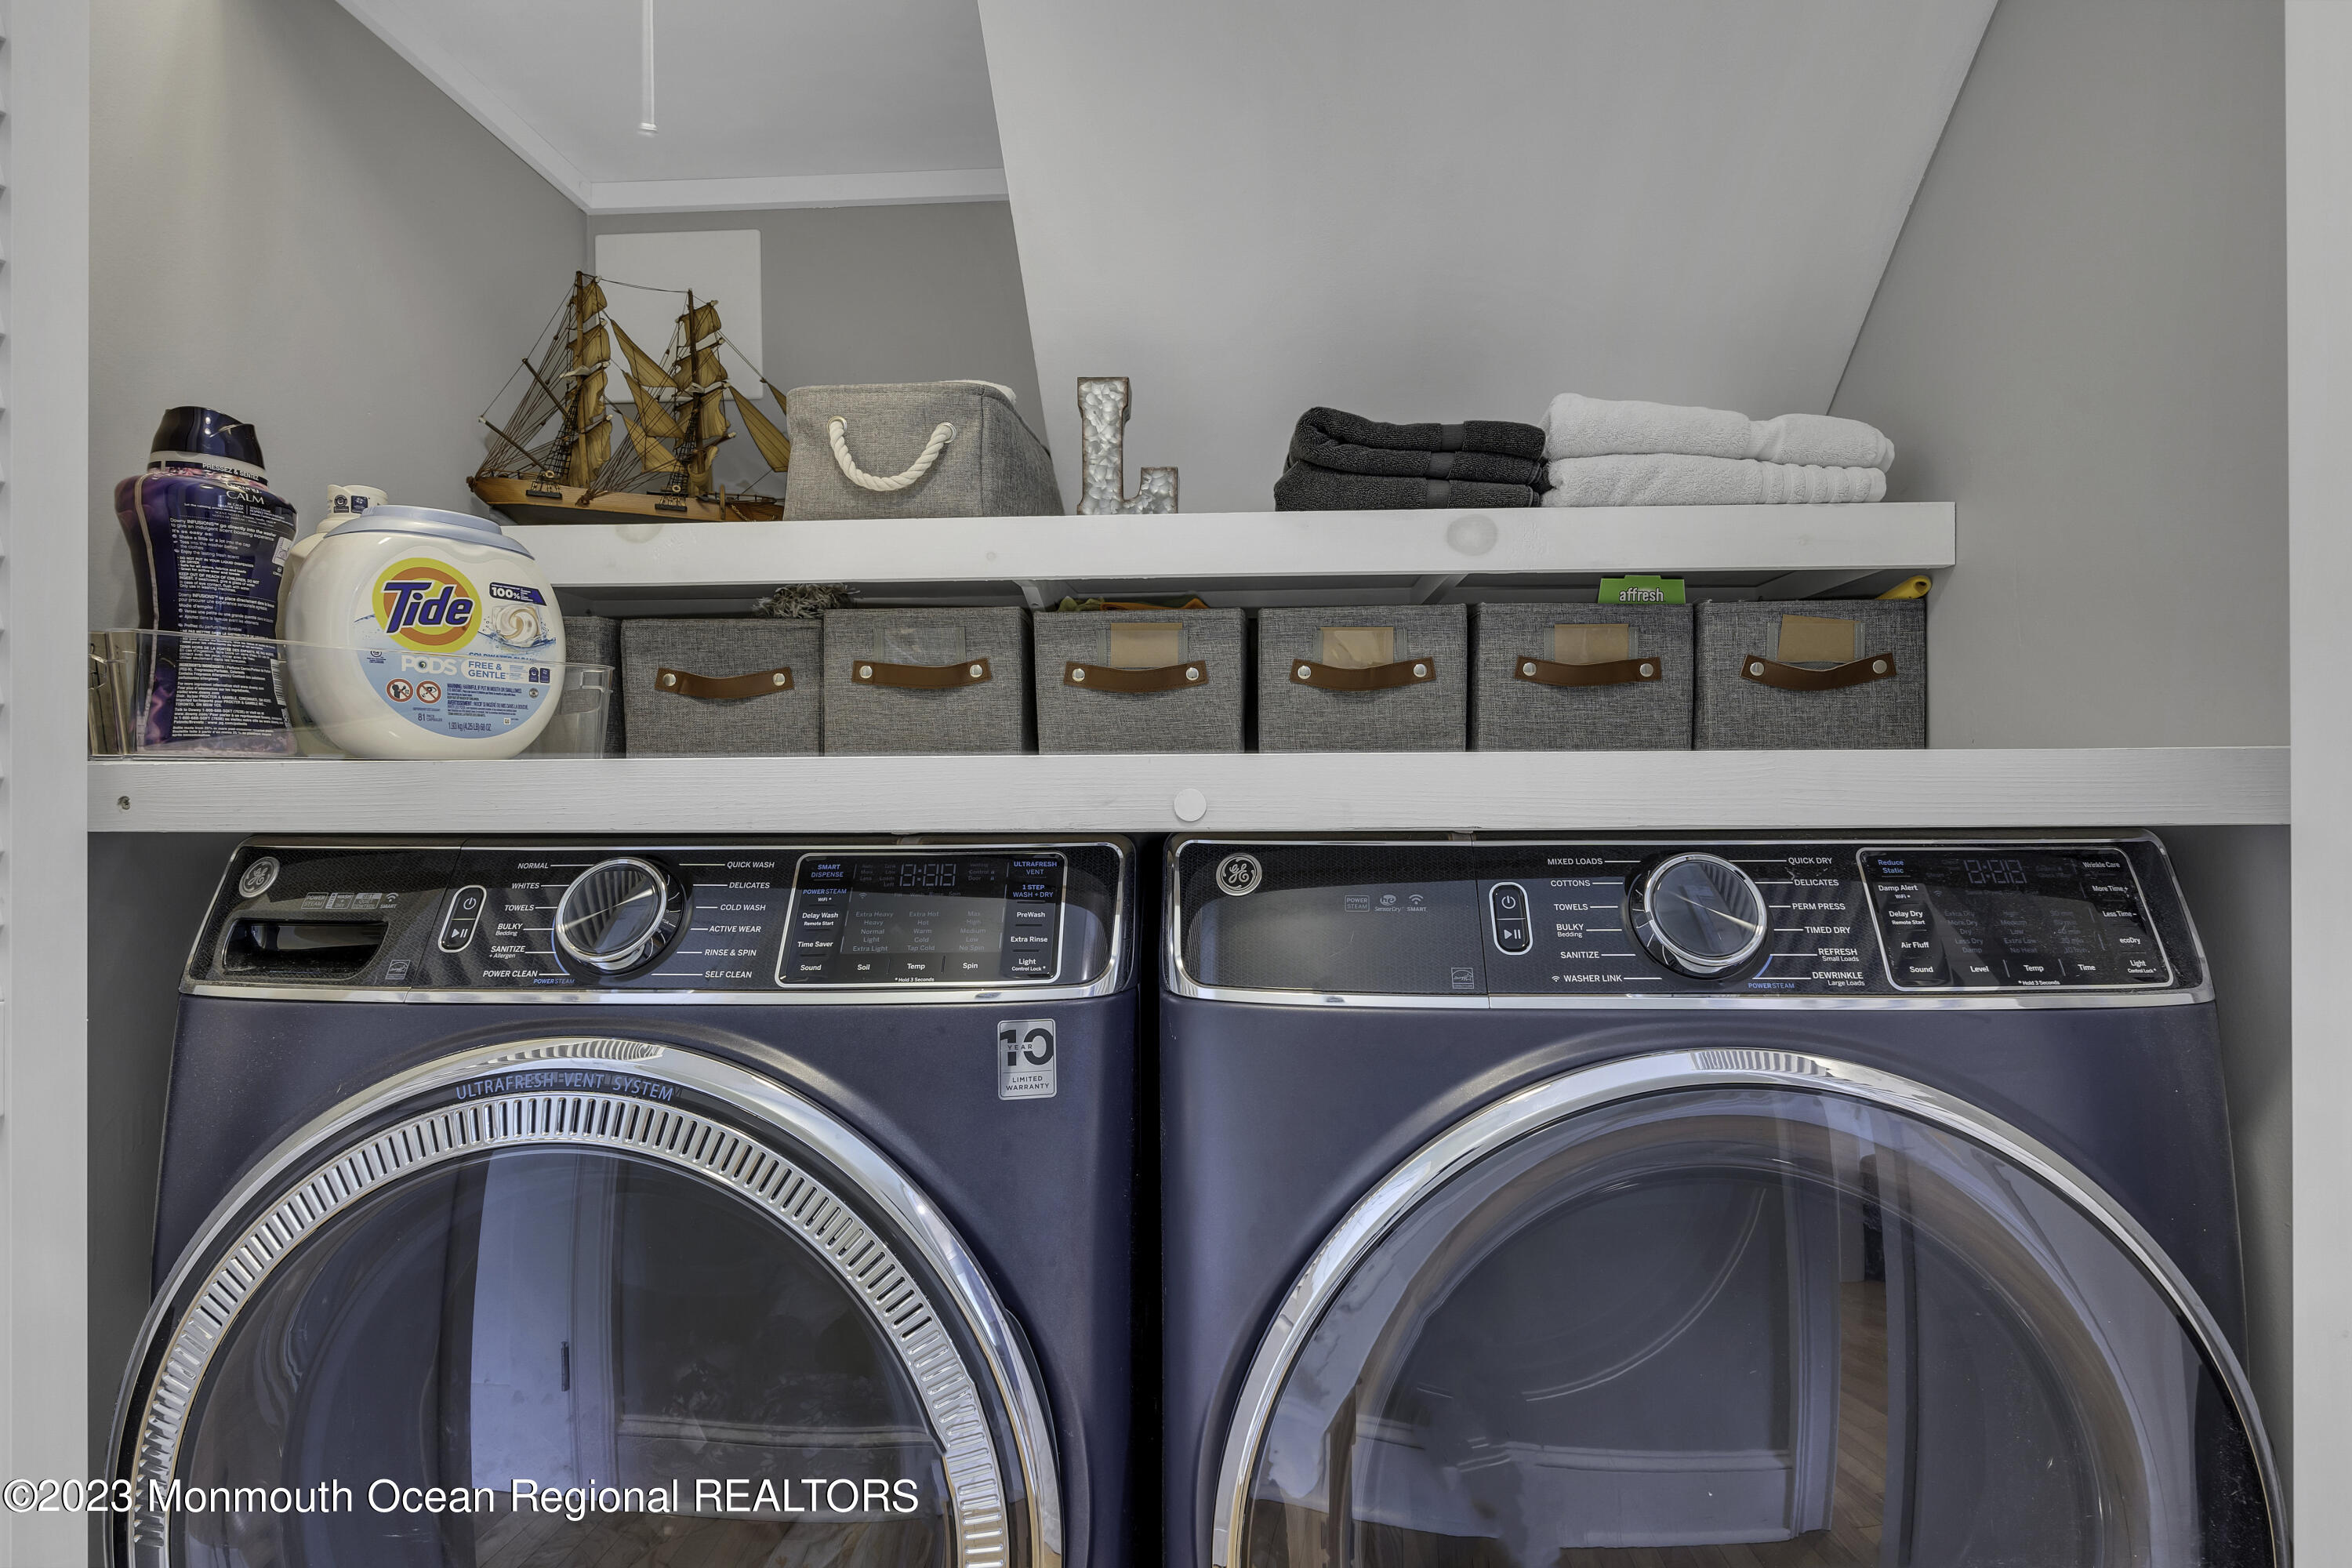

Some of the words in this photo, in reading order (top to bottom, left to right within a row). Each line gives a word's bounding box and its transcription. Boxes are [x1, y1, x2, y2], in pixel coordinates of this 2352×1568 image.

[202, 463, 232, 474] PRESSEZ
[240, 470, 259, 481] SENTEZ
[226, 490, 264, 505] CALM
[491, 587, 520, 599] 100%
[1618, 588, 1664, 603] affresh
[383, 581, 474, 634] Tide
[401, 655, 457, 675] PODS
[468, 661, 494, 670] FREE
[468, 670, 506, 679] GENTLE
[457, 723, 463, 731] kg
[1788, 857, 1810, 865] QUICK
[1556, 923, 1584, 931] BULKY
[1560, 951, 1600, 959] SANITIZE
[1812, 972, 1864, 980] DEWRINKLE
[1000, 1028, 1054, 1066] 10
[456, 1073, 553, 1100] ULTRAFRESH
[564, 1072, 604, 1089] VENT
[612, 1076, 673, 1101] SYSTEM
